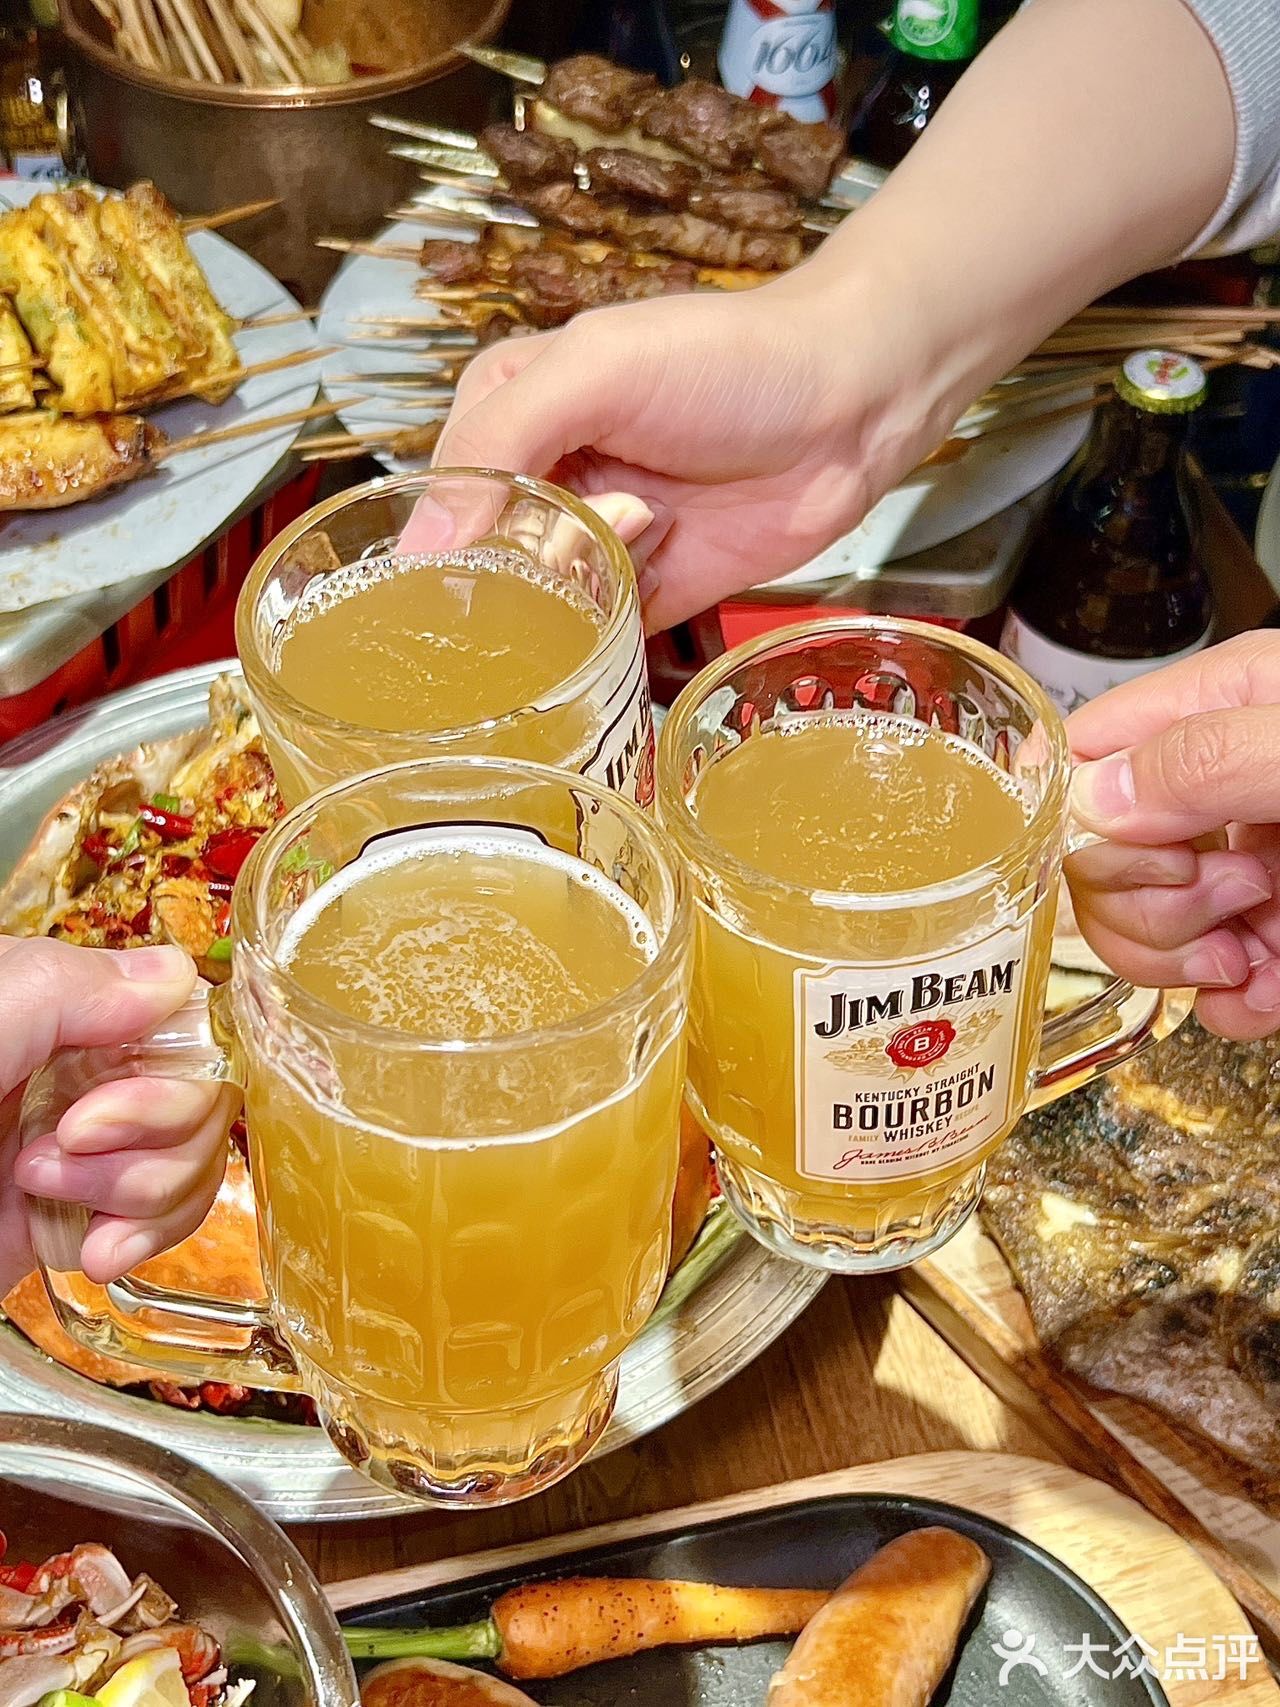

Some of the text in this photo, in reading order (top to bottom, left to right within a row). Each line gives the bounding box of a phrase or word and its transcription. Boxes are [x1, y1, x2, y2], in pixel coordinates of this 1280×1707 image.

[814, 960, 1018, 1039] JIM BEAM
[914, 1037, 929, 1052] B
[833, 1064, 995, 1131] BOURBON
[855, 1062, 981, 1103] KENTUCKY STRAIGHT
[848, 1134, 879, 1143] FAMILY
[883, 1114, 953, 1143] WHISKEY
